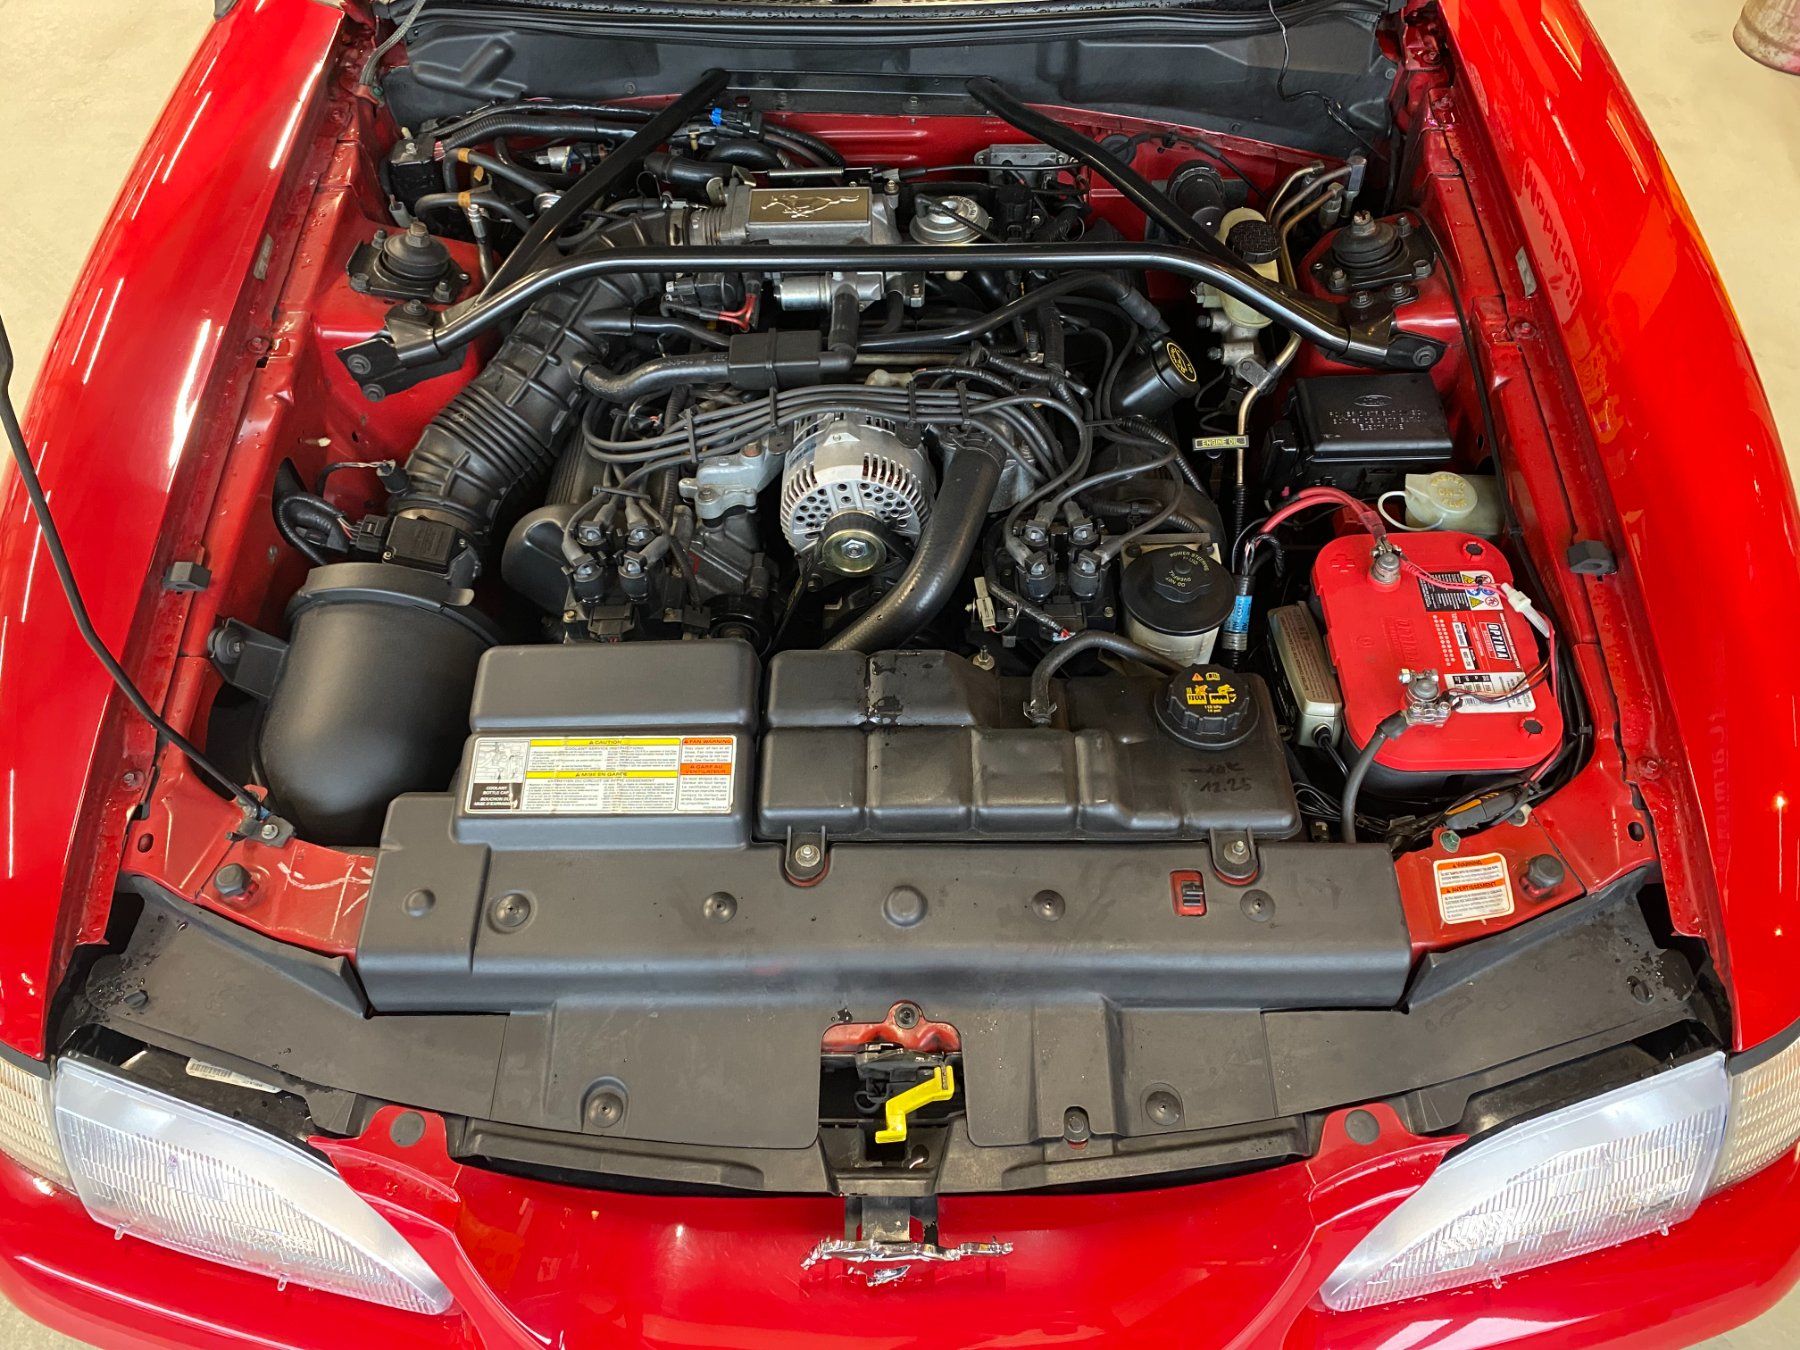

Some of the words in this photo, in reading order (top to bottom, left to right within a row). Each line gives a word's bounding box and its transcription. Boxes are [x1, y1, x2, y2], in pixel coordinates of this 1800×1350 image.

[1202, 438, 1226, 447] ENGINE
[1228, 438, 1238, 446] OIL
[1182, 556, 1198, 565] FLUID
[1190, 552, 1210, 571] STEERING
[1488, 624, 1510, 658] OPTIMA
[1200, 778, 1252, 792] 12.25
[1456, 860, 1482, 868] WARNING
